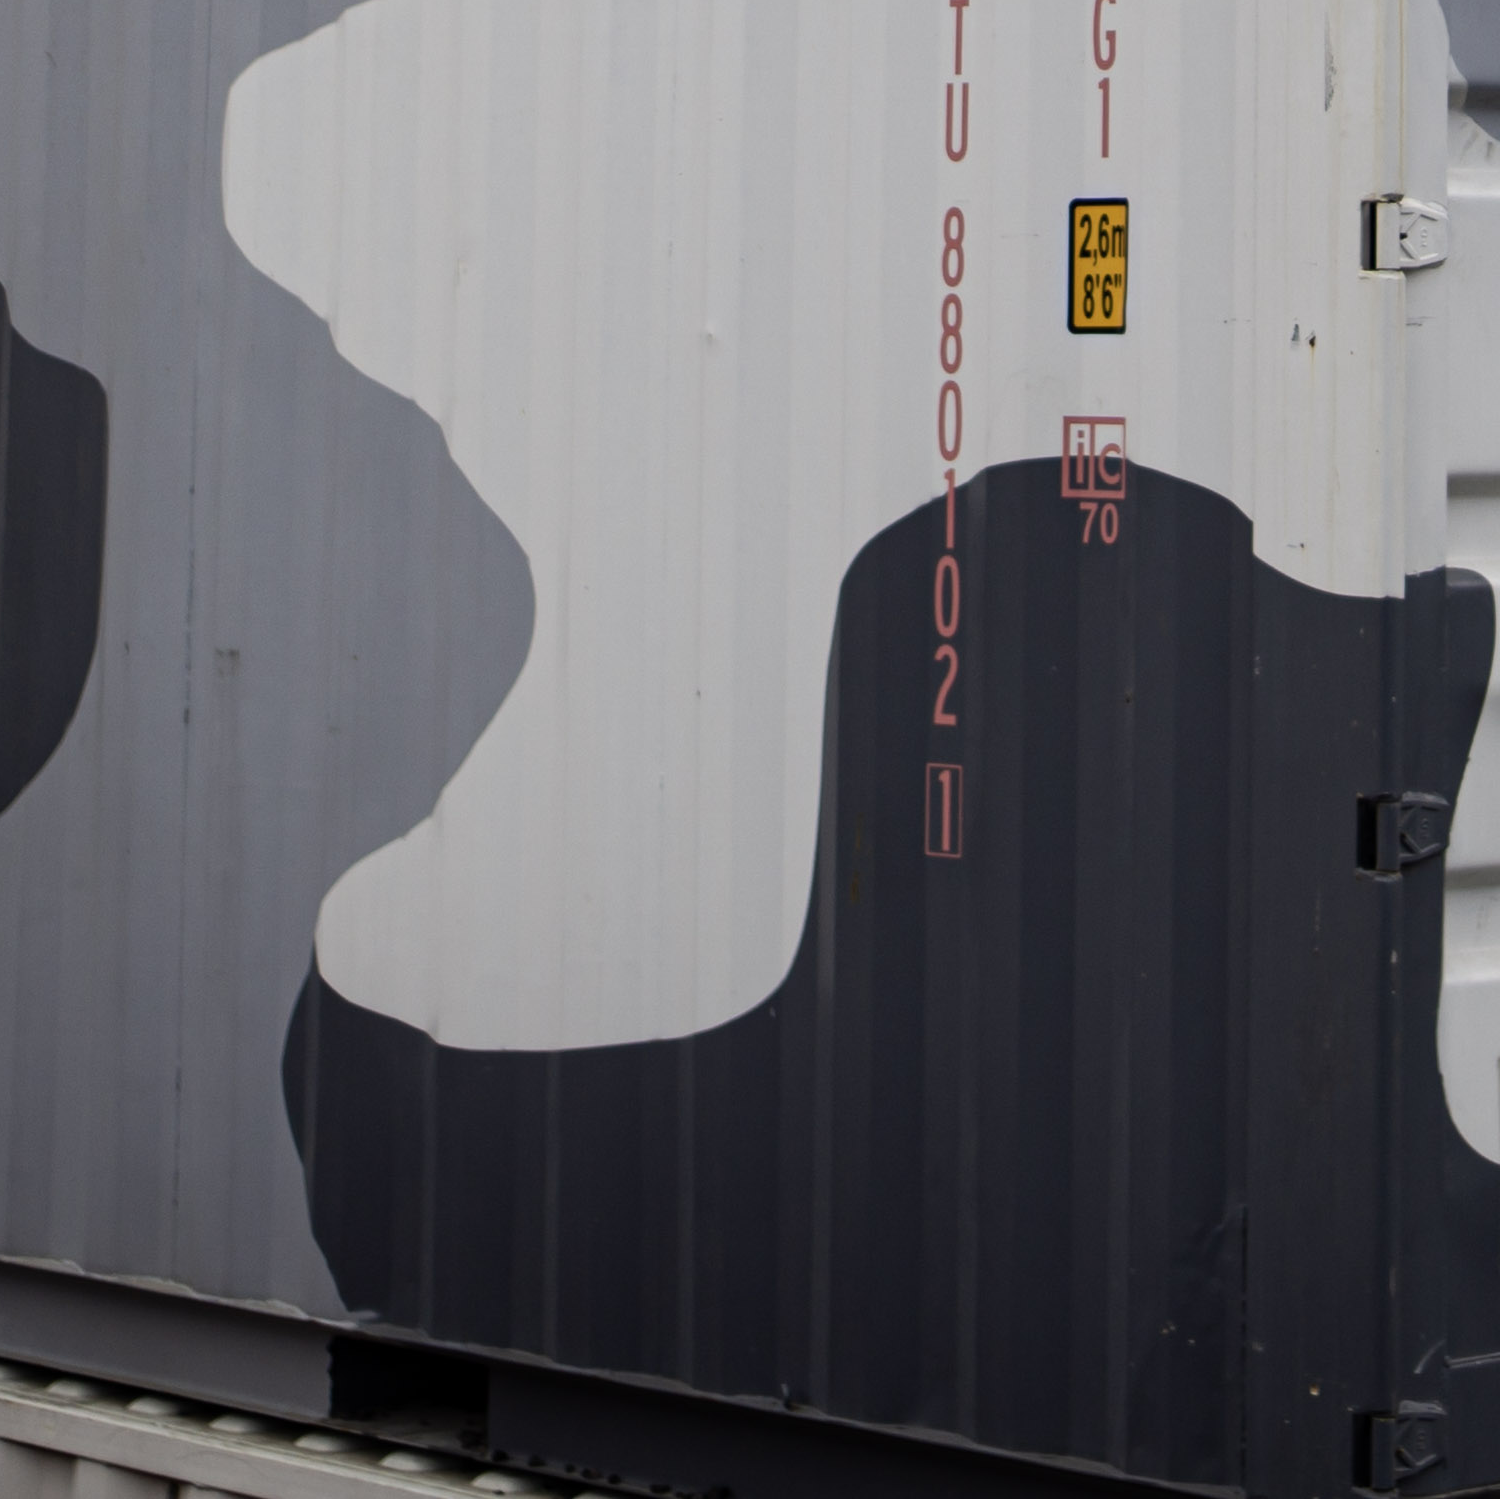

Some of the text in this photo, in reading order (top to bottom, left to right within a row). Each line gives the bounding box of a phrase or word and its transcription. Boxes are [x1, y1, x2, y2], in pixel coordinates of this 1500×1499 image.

[1078, 213, 1125, 266] 2,6m
[933, 206, 965, 727] 880102
[1078, 502, 1119, 545] 70
